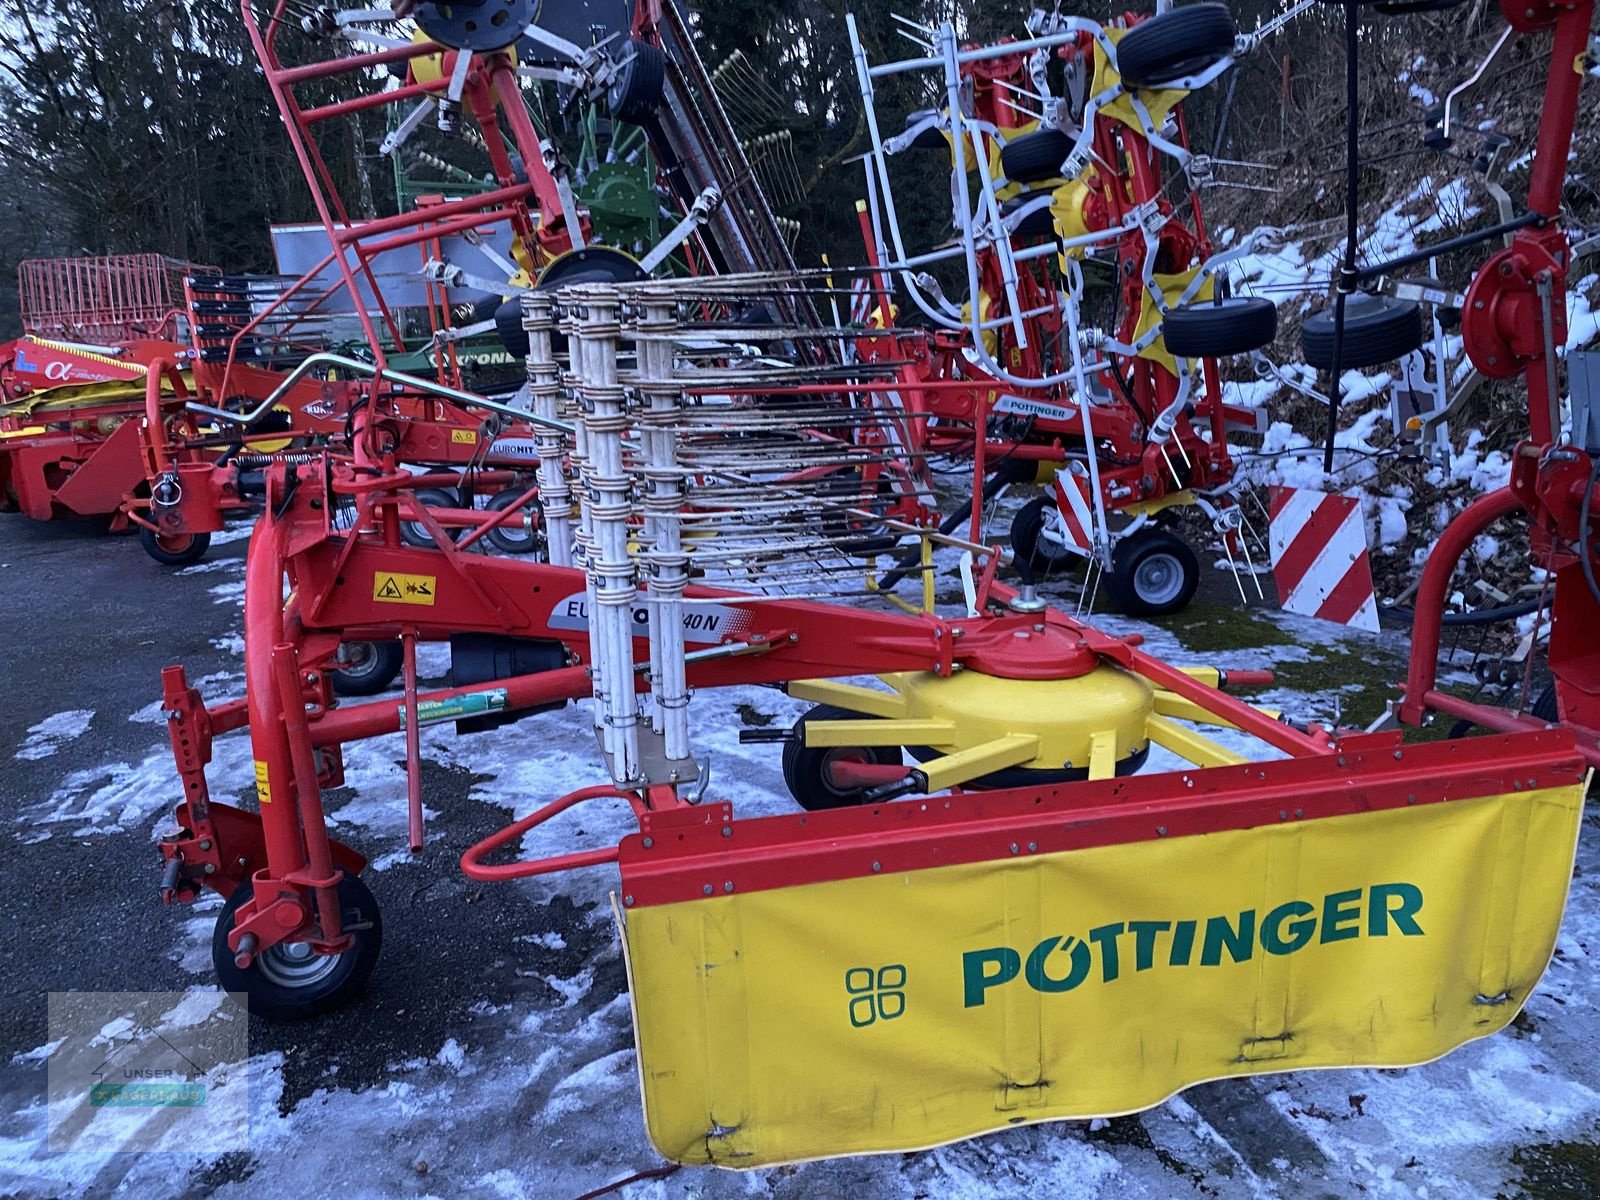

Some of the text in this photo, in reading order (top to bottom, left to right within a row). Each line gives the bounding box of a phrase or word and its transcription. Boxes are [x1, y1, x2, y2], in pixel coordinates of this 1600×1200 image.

[493, 445, 534, 454] EUROHIT
[682, 613, 720, 631] 40 N
[962, 882, 1425, 1008] PÖTTINGER
